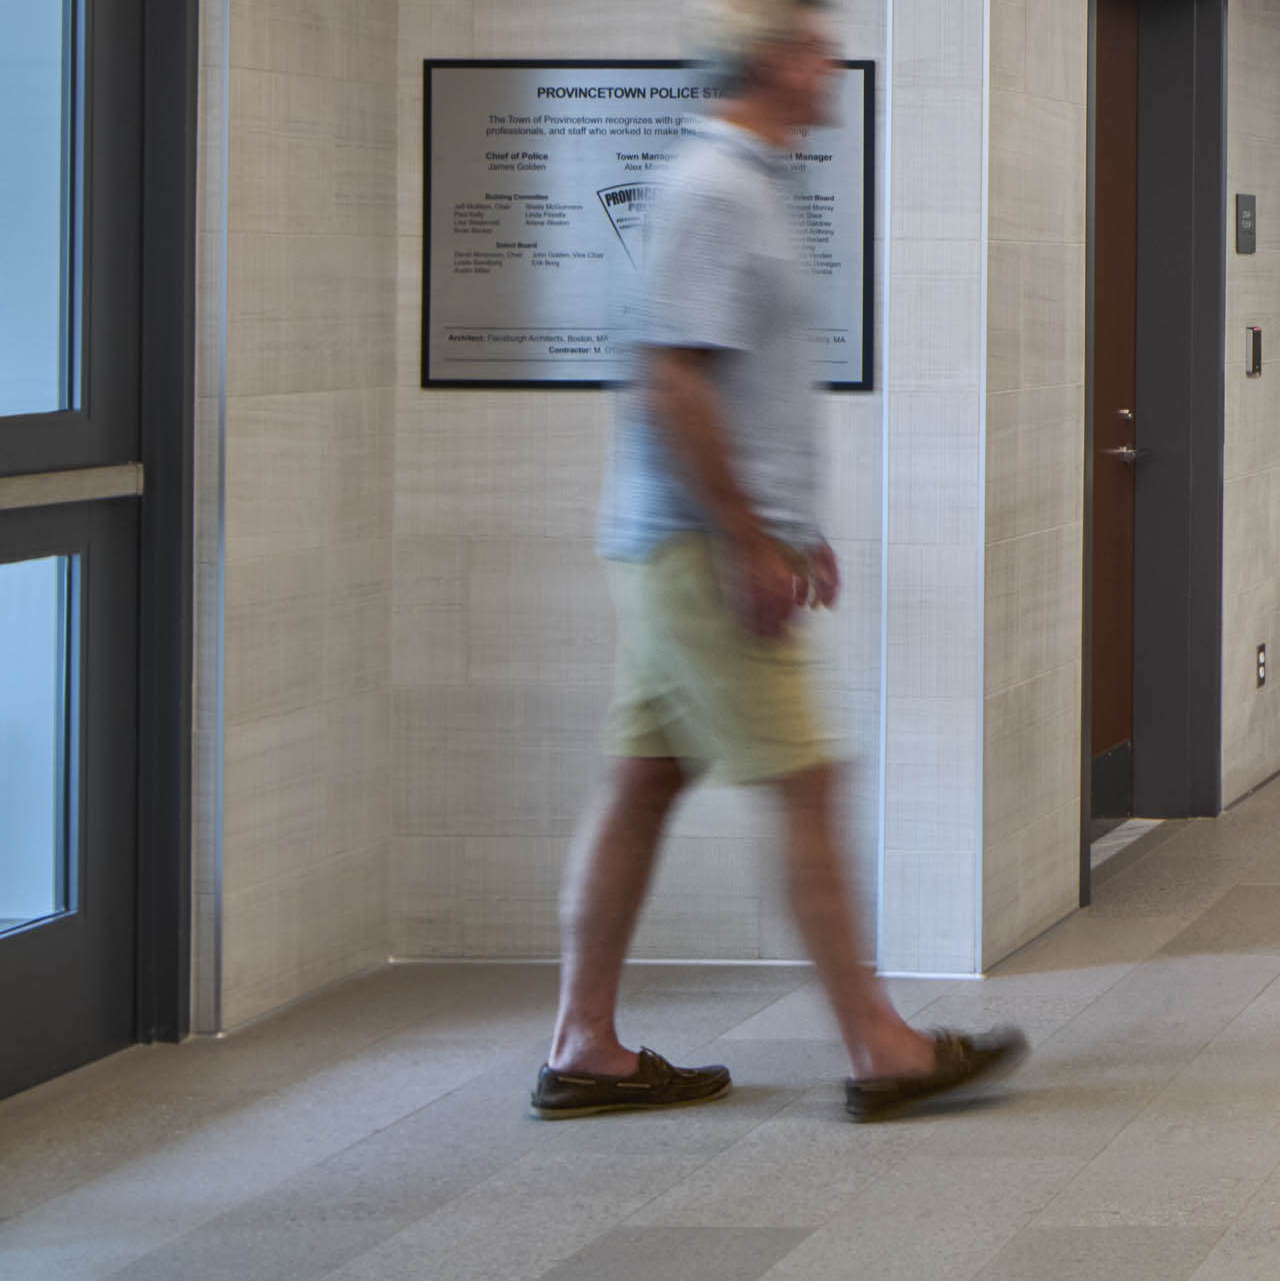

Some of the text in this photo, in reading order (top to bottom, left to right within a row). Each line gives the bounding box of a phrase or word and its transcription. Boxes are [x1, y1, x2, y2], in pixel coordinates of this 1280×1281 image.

[537, 86, 646, 99] PROVINCETOWN
[650, 86, 699, 99] POLICE
[489, 115, 505, 124] The
[508, 115, 531, 124] Town
[533, 115, 542, 124] of
[544, 115, 603, 124] Provincetown
[605, 115, 653, 127] recognizes
[655, 115, 673, 124] with
[549, 127, 566, 136] and
[568, 127, 587, 136] staff
[589, 127, 607, 136] who
[609, 127, 641, 136] worked
[643, 127, 652, 136] to
[655, 127, 679, 136] make
[485, 151, 549, 161] Chief of Police
[616, 152, 639, 161] Town
[795, 152, 833, 162] Manager
[833, 335, 847, 344] MA
